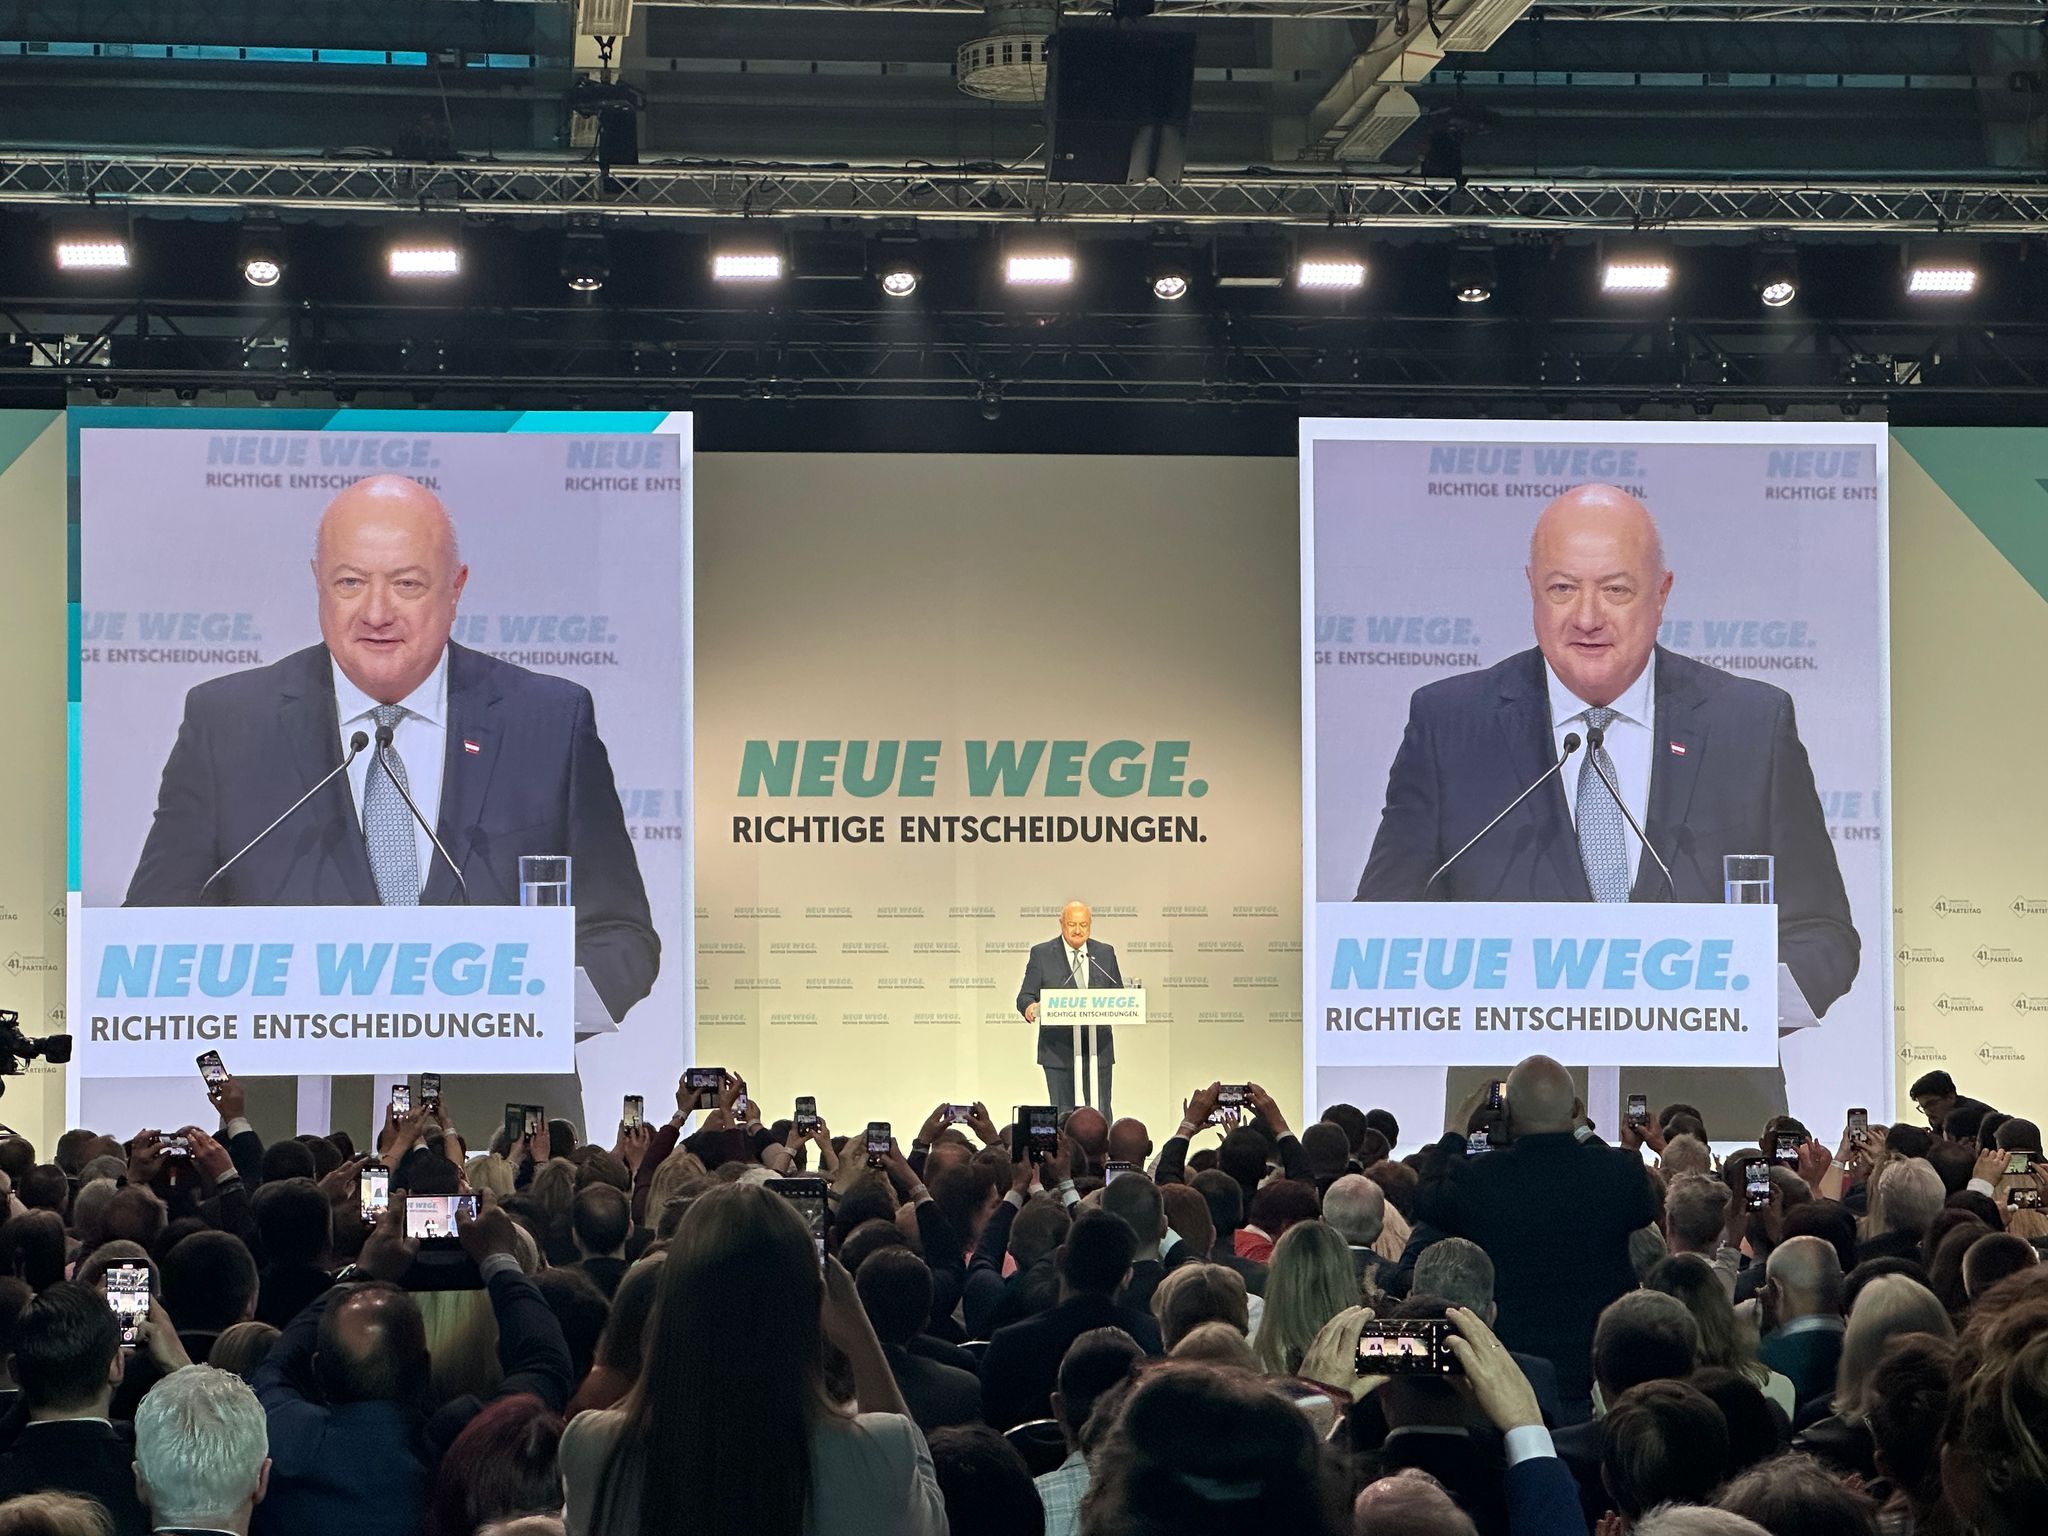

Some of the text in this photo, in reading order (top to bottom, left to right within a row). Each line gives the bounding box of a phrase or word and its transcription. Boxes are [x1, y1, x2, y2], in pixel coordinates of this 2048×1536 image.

[207, 436, 440, 468] NEUE WEGE.
[566, 441, 662, 469] NEUE
[1428, 446, 1647, 477] NEUE WEGE.
[1766, 450, 1861, 478] NEUE
[206, 473, 282, 488] RICHTIGE
[565, 477, 638, 491] RICHTIGE
[1428, 482, 1499, 497] RICHTIGE
[1765, 486, 1836, 500] RICHTIGE
[139, 612, 262, 642] WEGE.
[499, 615, 618, 643] WEGE.
[1366, 616, 1481, 645] WEGE.
[1703, 620, 1817, 648] WEGE.
[108, 649, 263, 664] ENTSCHEIDUNGEN.
[1339, 652, 1481, 667] ENTSCHEIDUNGEN.
[736, 739, 1209, 798] NEUE WEGE.
[733, 815, 1207, 843] RICHTIGE ENTSCHEIDUNGEN.
[97, 942, 546, 998] NEUE WEGE.
[1330, 938, 1750, 990] NEUE WEGE.
[1048, 996, 1140, 1009] NEUE WEGE.
[91, 1012, 544, 1041] RICHTIGE ENTSCHEIDUNGEN.
[1326, 1006, 1749, 1032] RICHTIGE ENTSCHEIDUNGEN.
